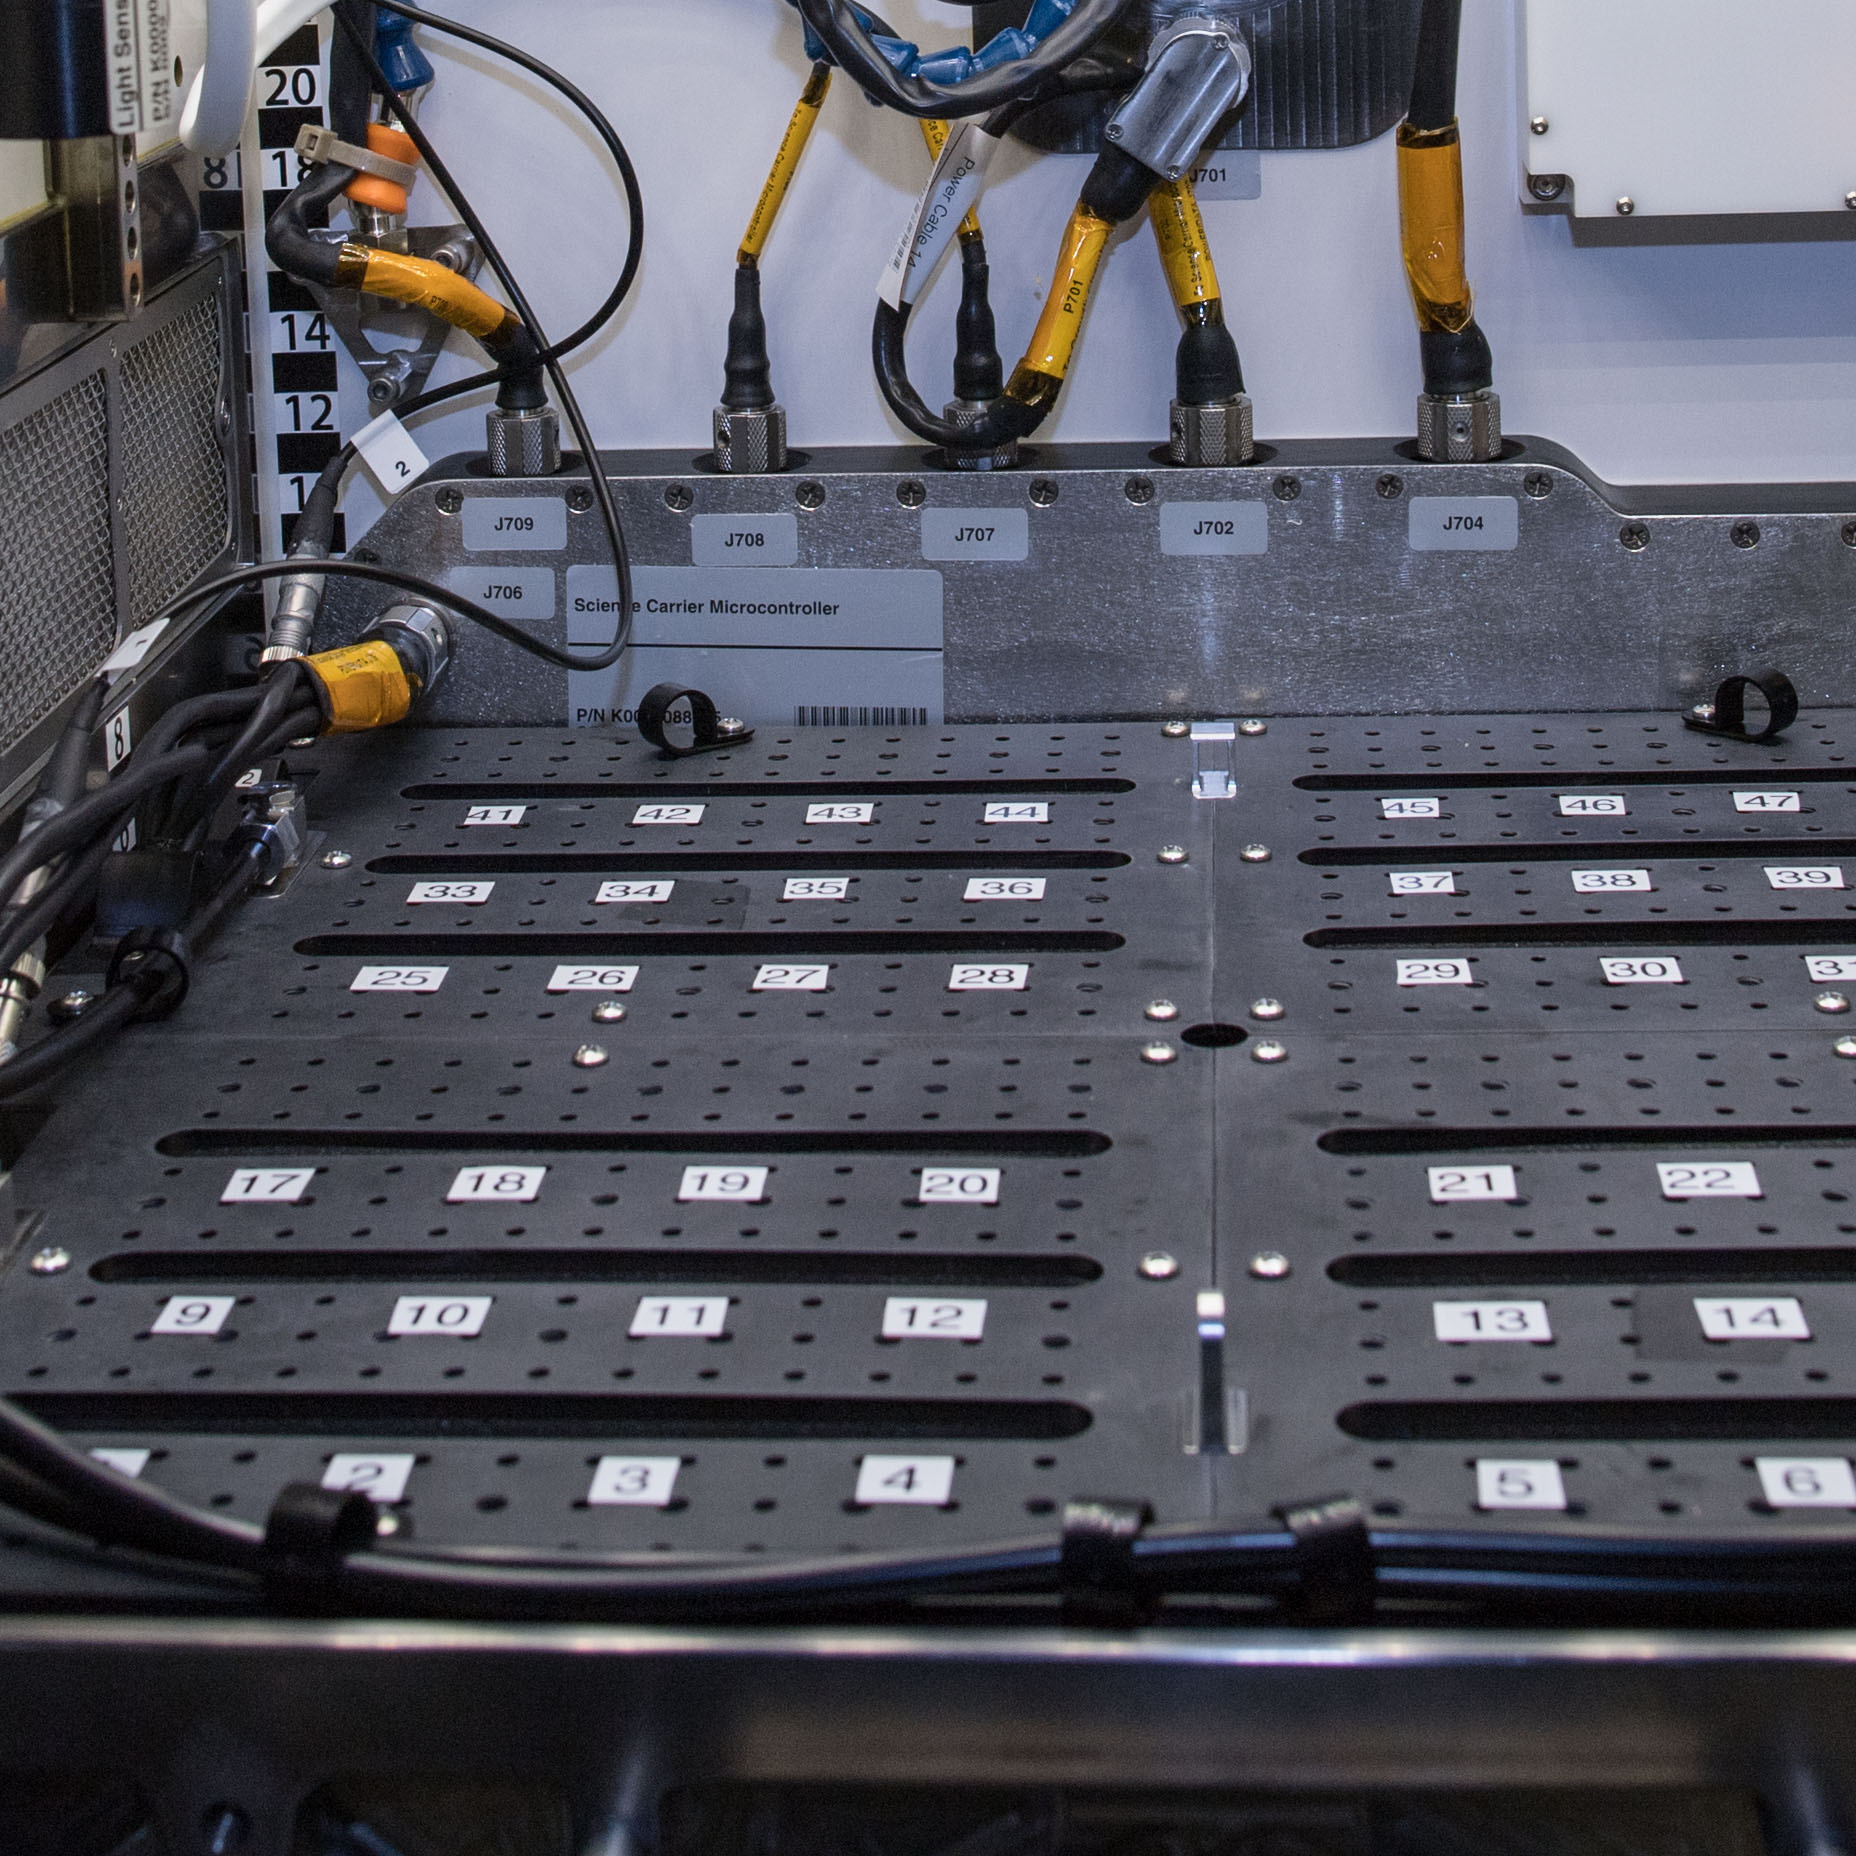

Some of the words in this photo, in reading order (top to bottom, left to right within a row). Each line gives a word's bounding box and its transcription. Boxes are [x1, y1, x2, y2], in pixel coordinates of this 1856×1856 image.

[265, 67, 316, 106] 20
[113, 87, 133, 128] Light
[941, 156, 976, 204] Power
[1189, 167, 1227, 184] J701
[919, 203, 949, 246] Cable
[907, 250, 923, 269] 14
[1063, 279, 1084, 314] P701
[280, 312, 331, 351] 14
[285, 393, 334, 432] 12
[393, 459, 411, 478] 2
[493, 516, 535, 533] J709
[1192, 519, 1235, 538] J702
[1442, 514, 1485, 532] J704
[724, 532, 765, 548] J708
[954, 526, 996, 543] J707
[482, 585, 523, 601] J706
[574, 597, 641, 615] Sciene
[646, 598, 705, 615] Carrier
[710, 599, 841, 617] Microcontroller
[576, 707, 606, 724] P/N
[1383, 801, 1433, 815] 45
[1566, 798, 1618, 814] 46
[1744, 794, 1795, 809] 47
[467, 808, 514, 822] 41
[639, 807, 691, 820] 42
[812, 806, 863, 820] 43
[988, 806, 1038, 819] 44
[1398, 874, 1450, 891] 37
[1581, 873, 1638, 888] 38
[1776, 869, 1833, 886] 39
[428, 884, 479, 899] 33
[605, 883, 659, 899] 34
[790, 881, 844, 896] 35
[981, 881, 1034, 896] 36
[371, 970, 428, 986] 25
[568, 969, 625, 986] 26
[763, 969, 821, 985] 27
[958, 969, 1016, 985] 28
[1406, 963, 1461, 979] 29
[1610, 962, 1669, 978] 30
[242, 1174, 299, 1196] 17
[472, 1173, 527, 1195] 18
[697, 1173, 751, 1194] 19
[926, 1175, 989, 1195] 20
[1439, 1172, 1495, 1194] 21
[1667, 1169, 1732, 1191] 22
[180, 1304, 212, 1324] 9
[411, 1304, 471, 1327] 10
[659, 1304, 706, 1328] 11
[907, 1305, 964, 1329] 12
[1470, 1310, 1530, 1332] 13
[1723, 1307, 1782, 1329] 14
[350, 1463, 386, 1490] 2
[616, 1468, 651, 1493] 3
[883, 1465, 919, 1493] 4
[1498, 1472, 1534, 1494] 5
[1784, 1472, 1821, 1494] 6
